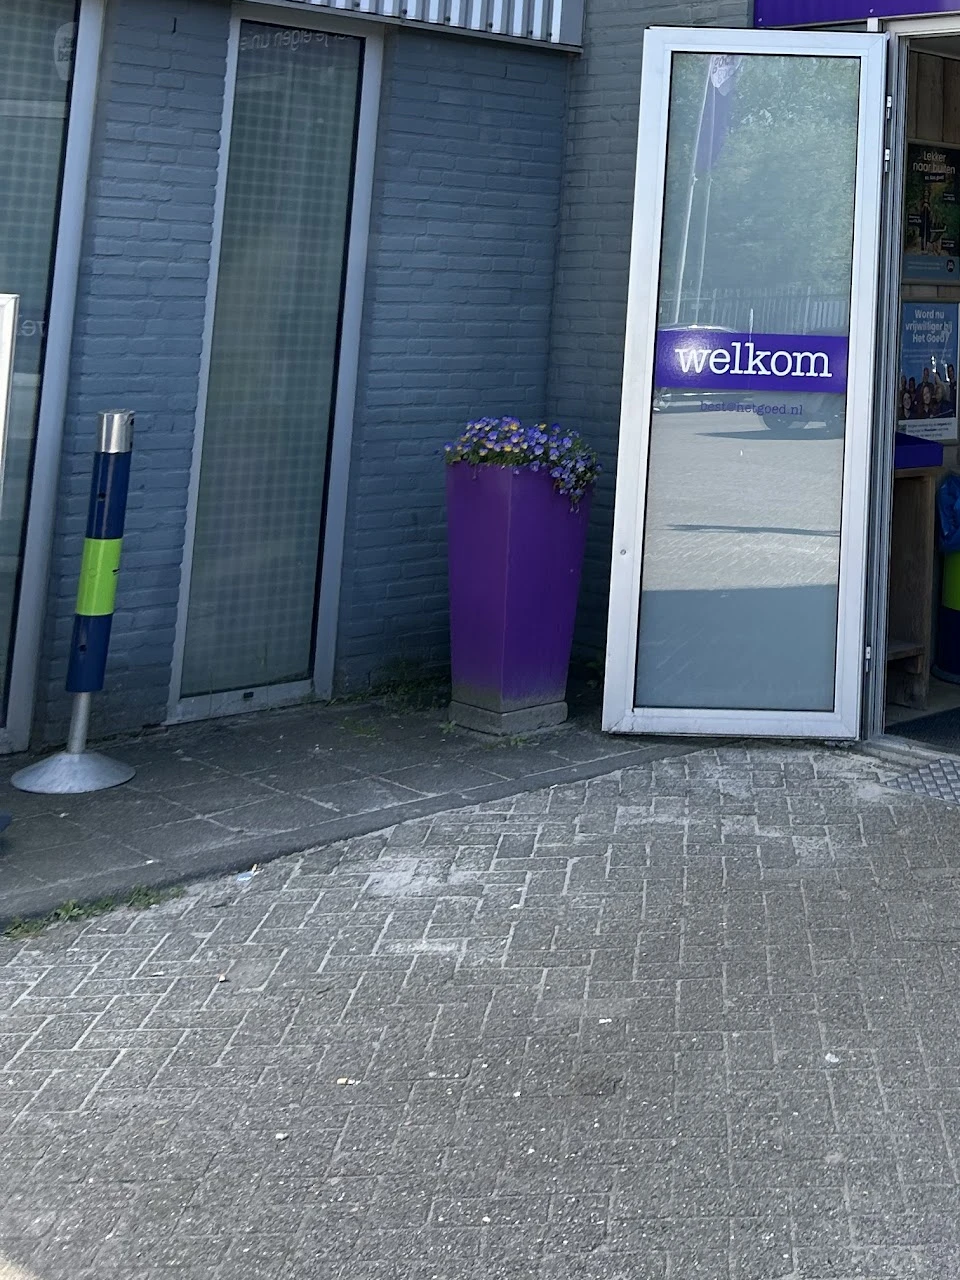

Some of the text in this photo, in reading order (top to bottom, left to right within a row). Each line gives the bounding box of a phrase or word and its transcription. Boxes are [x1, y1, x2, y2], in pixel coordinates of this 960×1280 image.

[923, 151, 946, 163] Lekker
[932, 162, 955, 174] buiten
[914, 309, 945, 319] Word nu
[905, 320, 953, 333] vrijwilliger bij
[912, 332, 945, 343] Het Goed
[675, 342, 832, 377] welkom
[700, 401, 803, 416] best@hetgoed.nl
